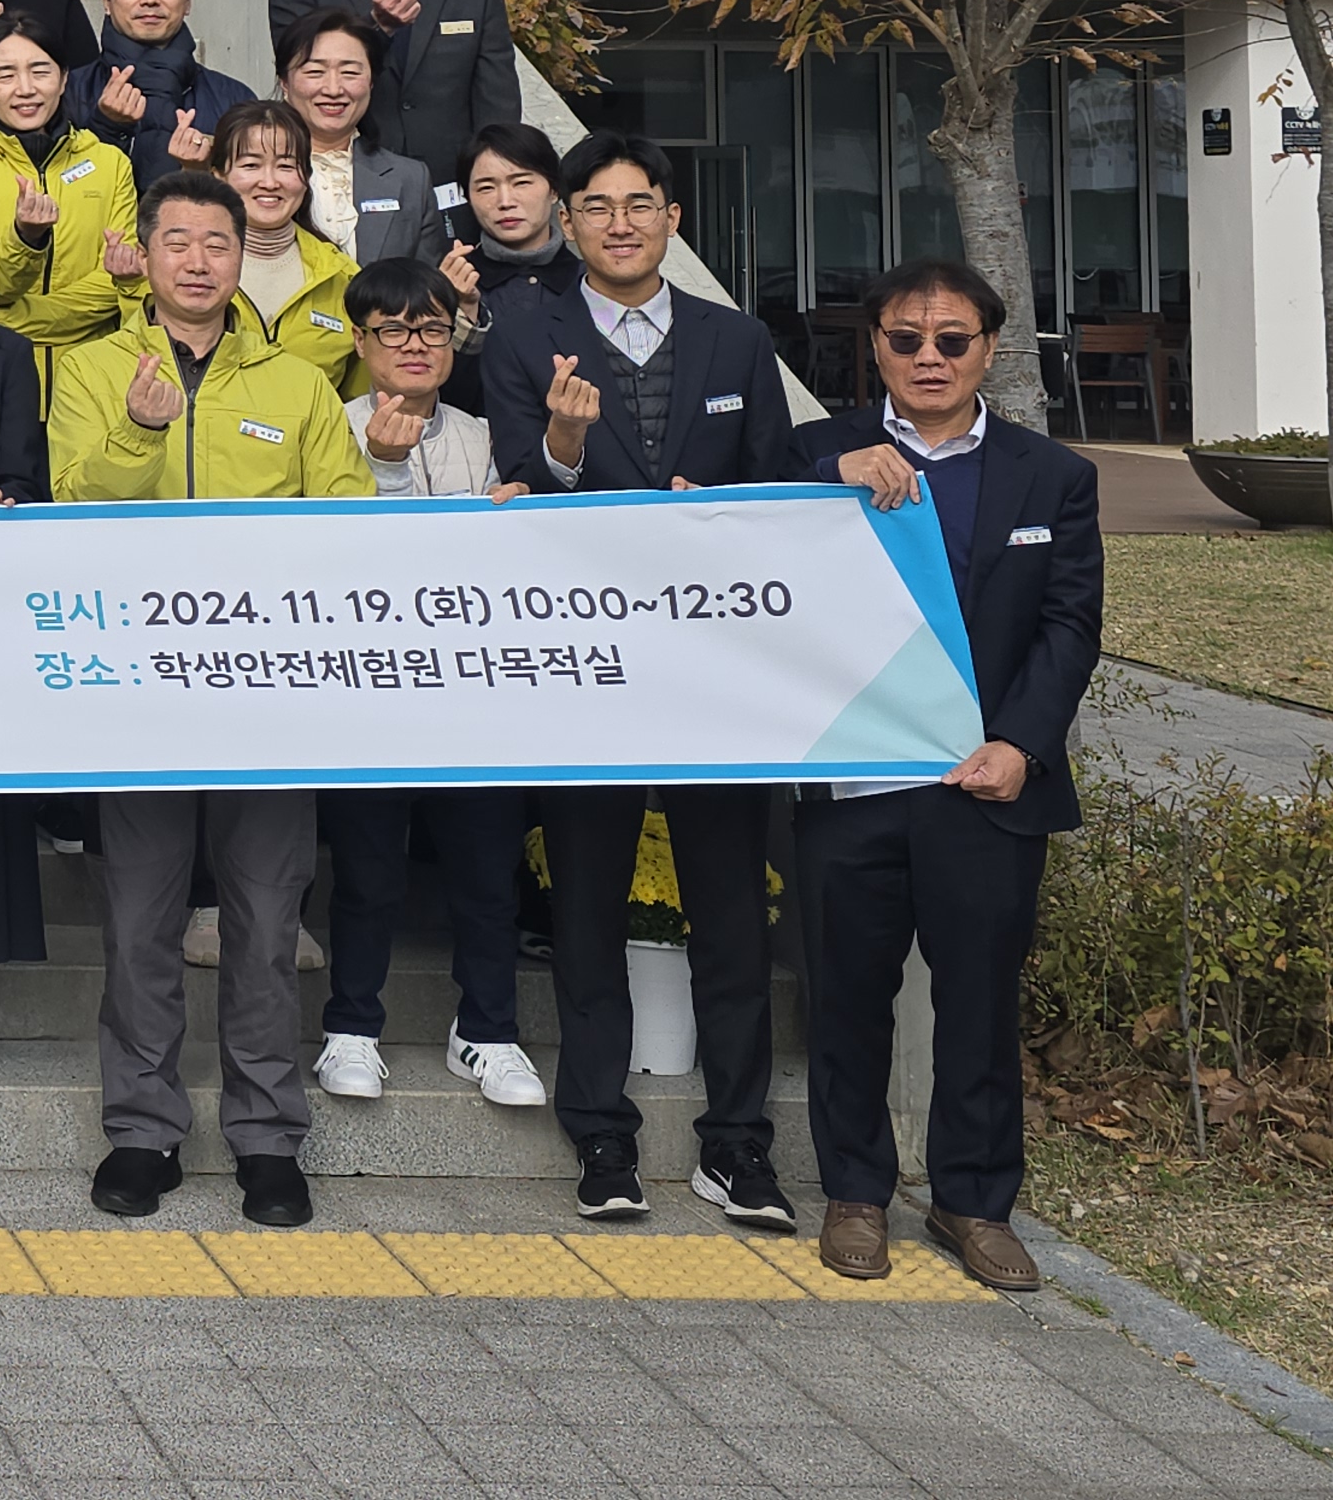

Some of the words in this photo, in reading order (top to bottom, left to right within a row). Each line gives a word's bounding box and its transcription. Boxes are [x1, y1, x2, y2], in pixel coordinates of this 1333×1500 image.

[25, 590, 106, 631] 일시
[141, 591, 271, 626] 2024.
[281, 590, 335, 624] 11.
[344, 588, 403, 623] 19.
[414, 585, 493, 627] (화)
[502, 580, 792, 622] 10:00~12:30
[34, 651, 121, 690] 장소
[149, 647, 445, 689] 학생안전체험원
[454, 644, 627, 688] 다목적실
